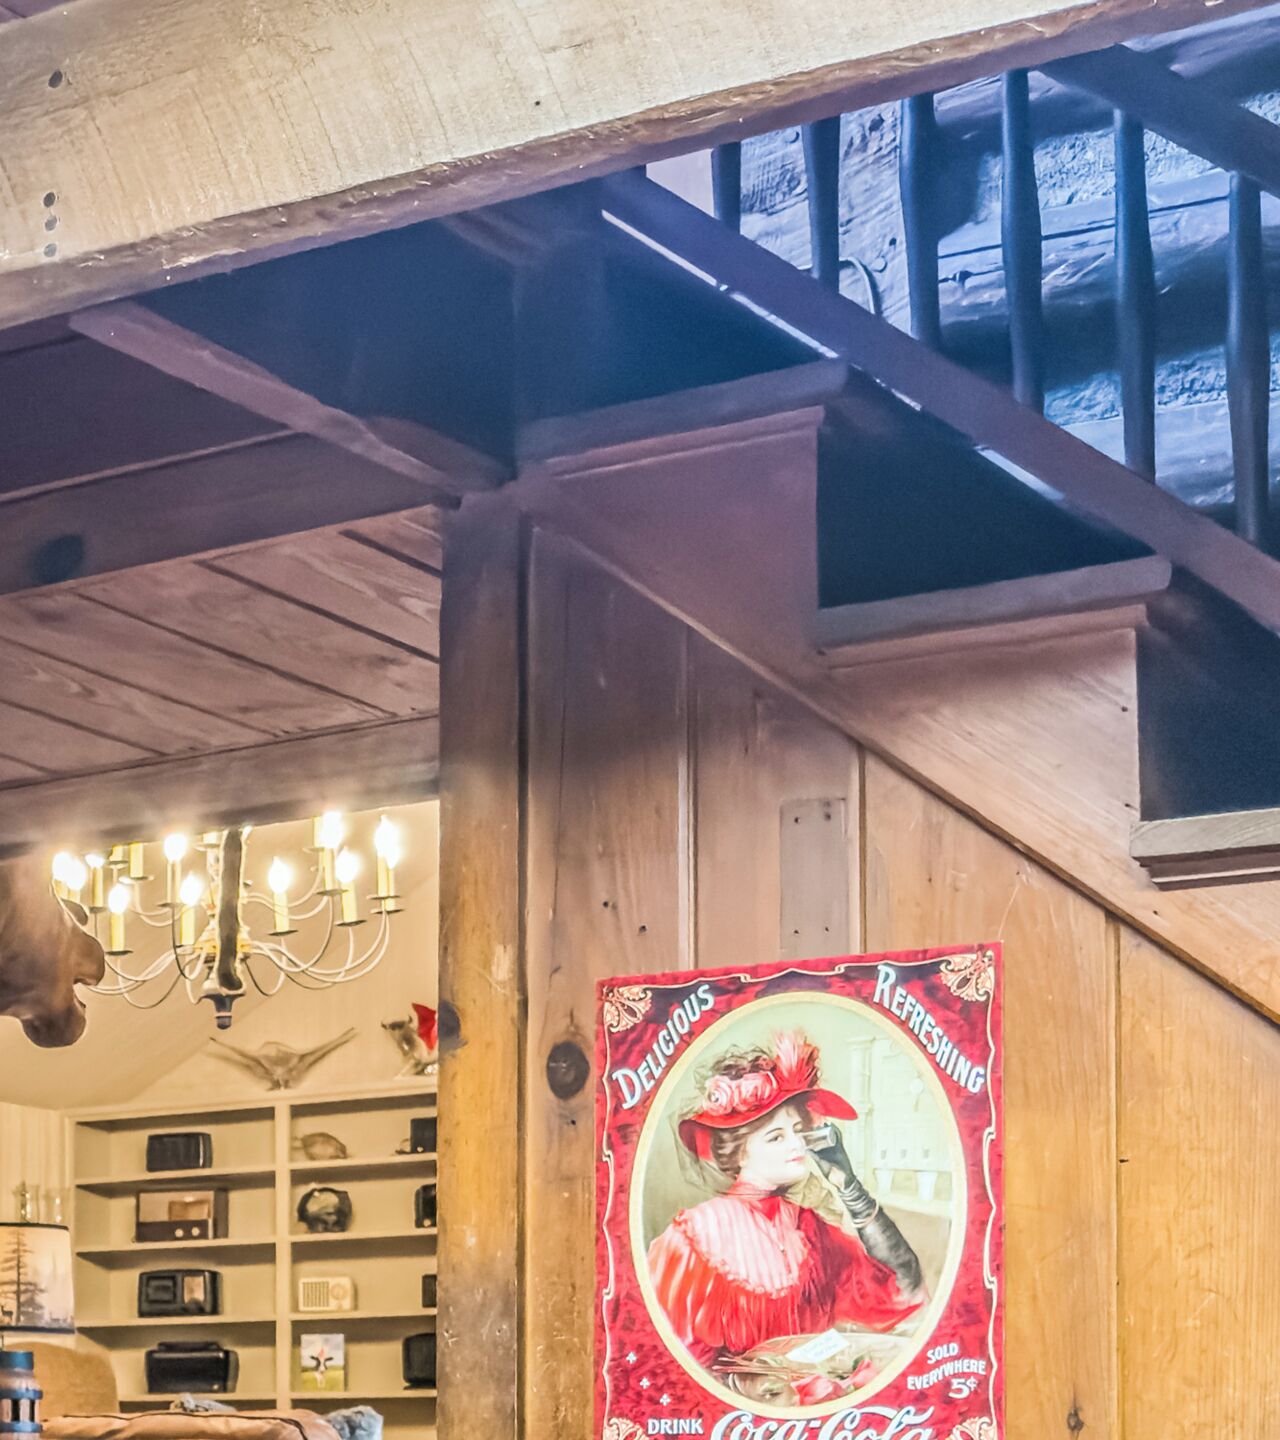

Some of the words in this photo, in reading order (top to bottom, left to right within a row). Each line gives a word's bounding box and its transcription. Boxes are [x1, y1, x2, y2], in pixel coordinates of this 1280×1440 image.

[611, 984, 715, 1110] DELICIOUS
[873, 964, 985, 1094] REFRESHING
[926, 1342, 959, 1365] SOLD
[906, 1359, 987, 1390] EVERYWHERE
[647, 1418, 704, 1435] DRINK
